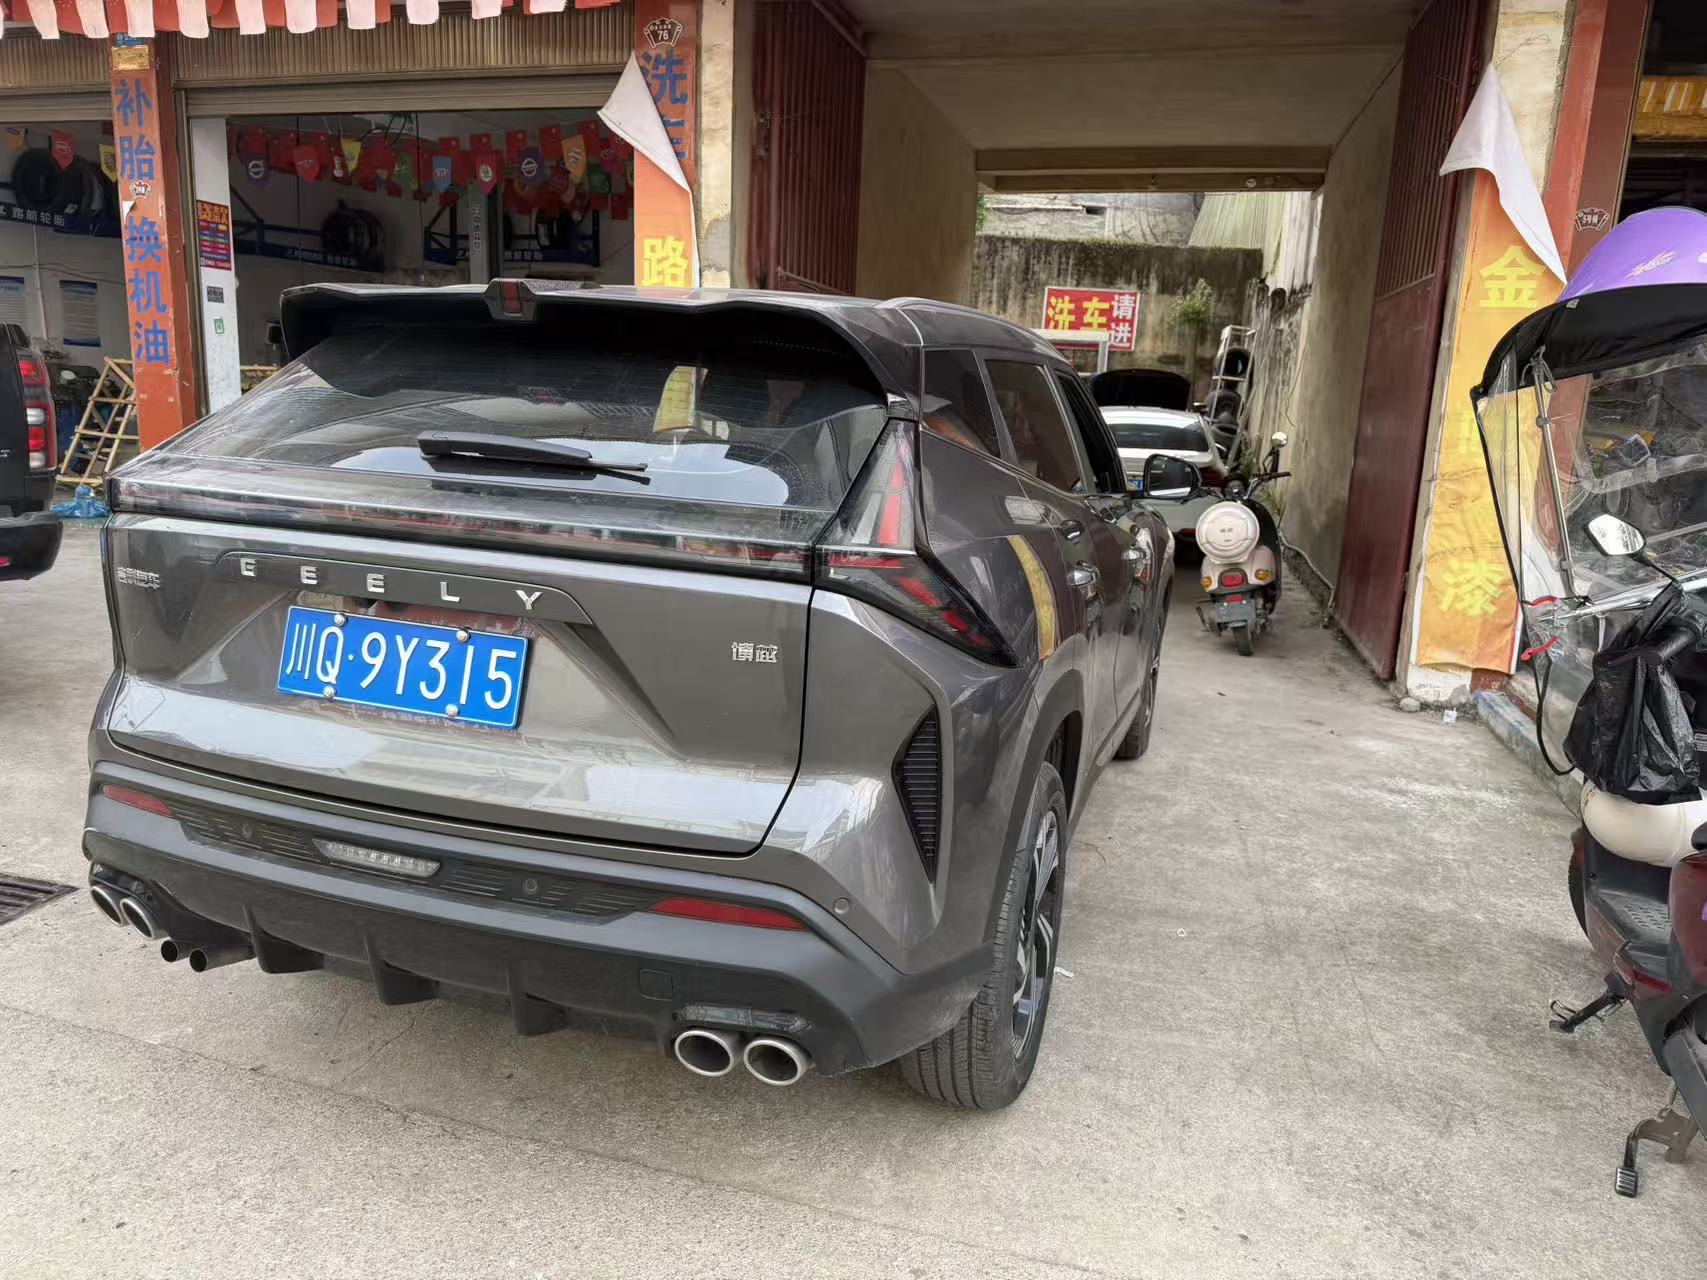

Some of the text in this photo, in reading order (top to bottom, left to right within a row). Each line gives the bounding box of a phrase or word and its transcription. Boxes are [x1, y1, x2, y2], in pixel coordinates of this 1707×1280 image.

[657, 30, 669, 41] 76
[641, 235, 690, 288] 路
[1047, 295, 1110, 332] 洗车
[1106, 294, 1135, 348] 请进
[239, 558, 543, 611] GEELY
[286, 622, 518, 711] 川Q·9Y315
